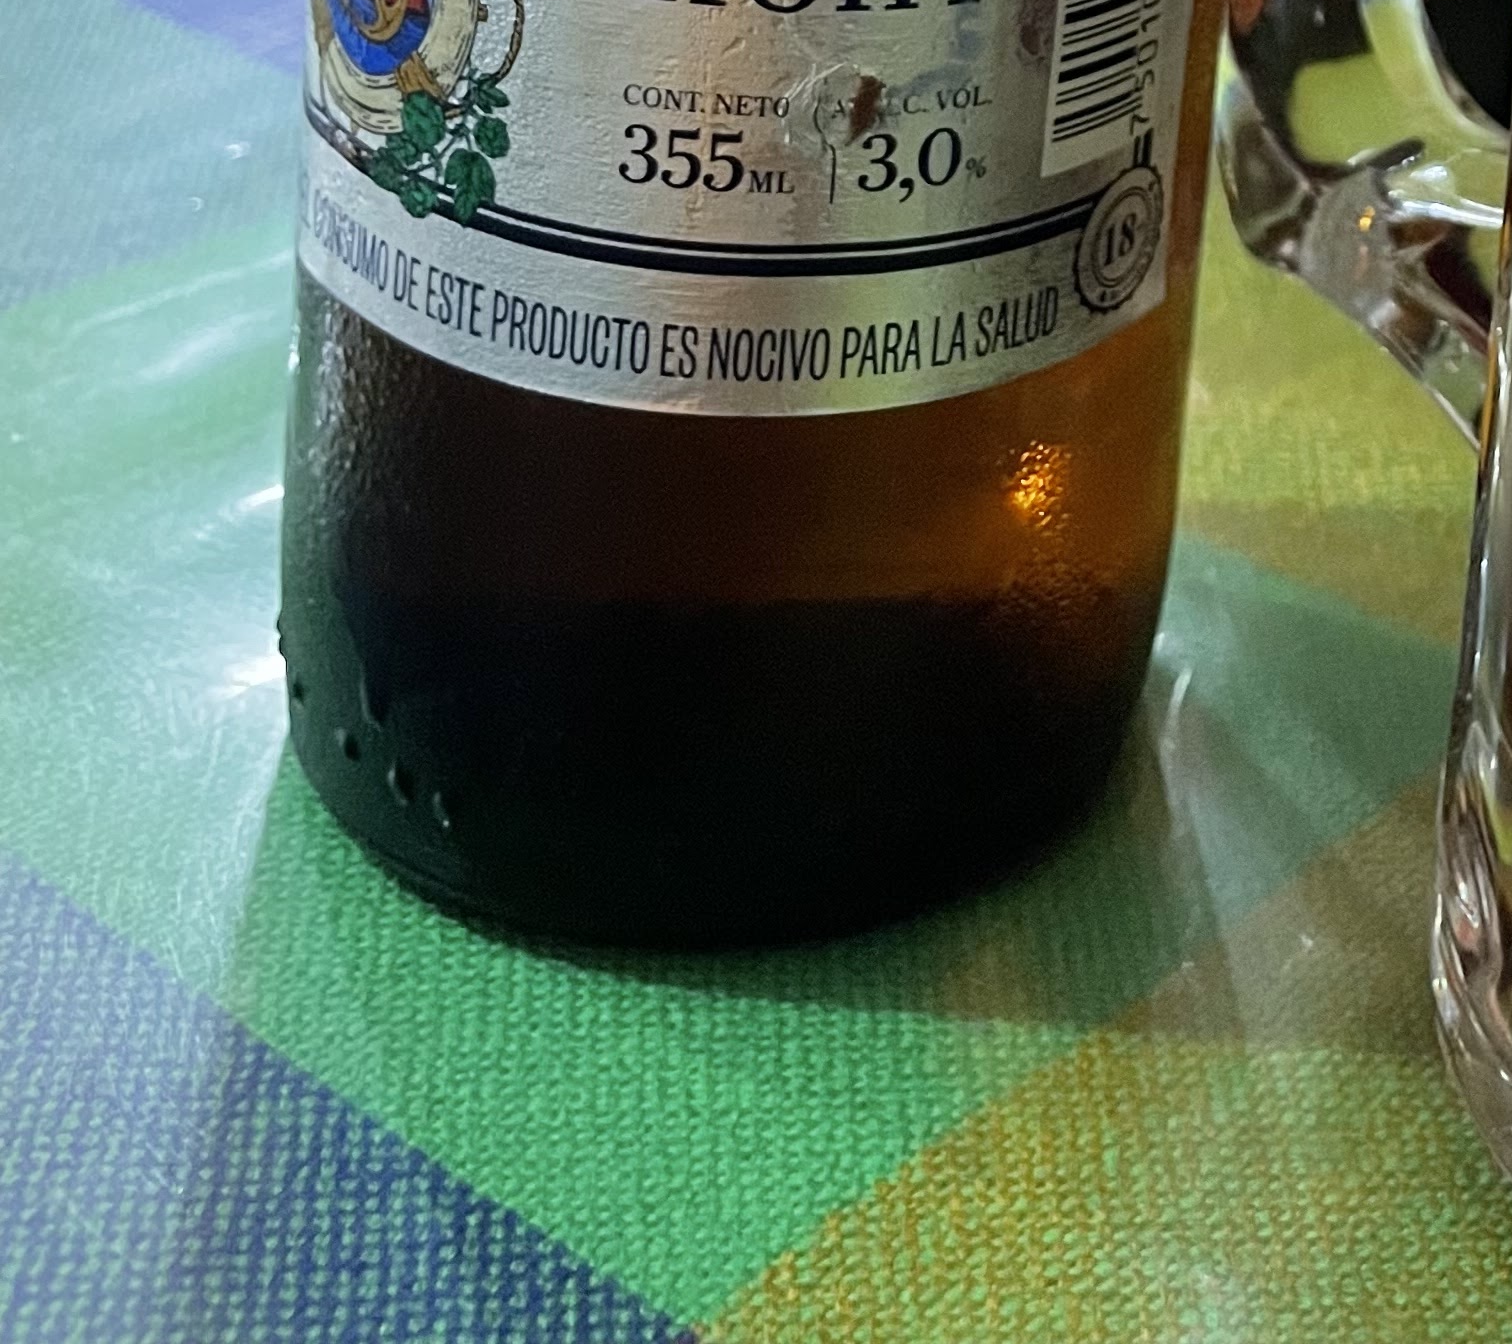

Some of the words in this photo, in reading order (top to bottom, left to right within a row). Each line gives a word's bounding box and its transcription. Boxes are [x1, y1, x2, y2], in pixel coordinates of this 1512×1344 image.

[623, 83, 705, 114] CONT.
[713, 91, 791, 120] NETO
[937, 85, 993, 111] VOL.
[393, 249, 420, 311] DE
[425, 266, 485, 338] ESTE
[490, 288, 650, 375] PRODUCTO
[660, 323, 700, 380] ES
[706, 325, 831, 384] NOCIVO
[839, 317, 921, 379] PARA
[931, 313, 967, 368] LA
[974, 285, 1060, 359] SALUD
